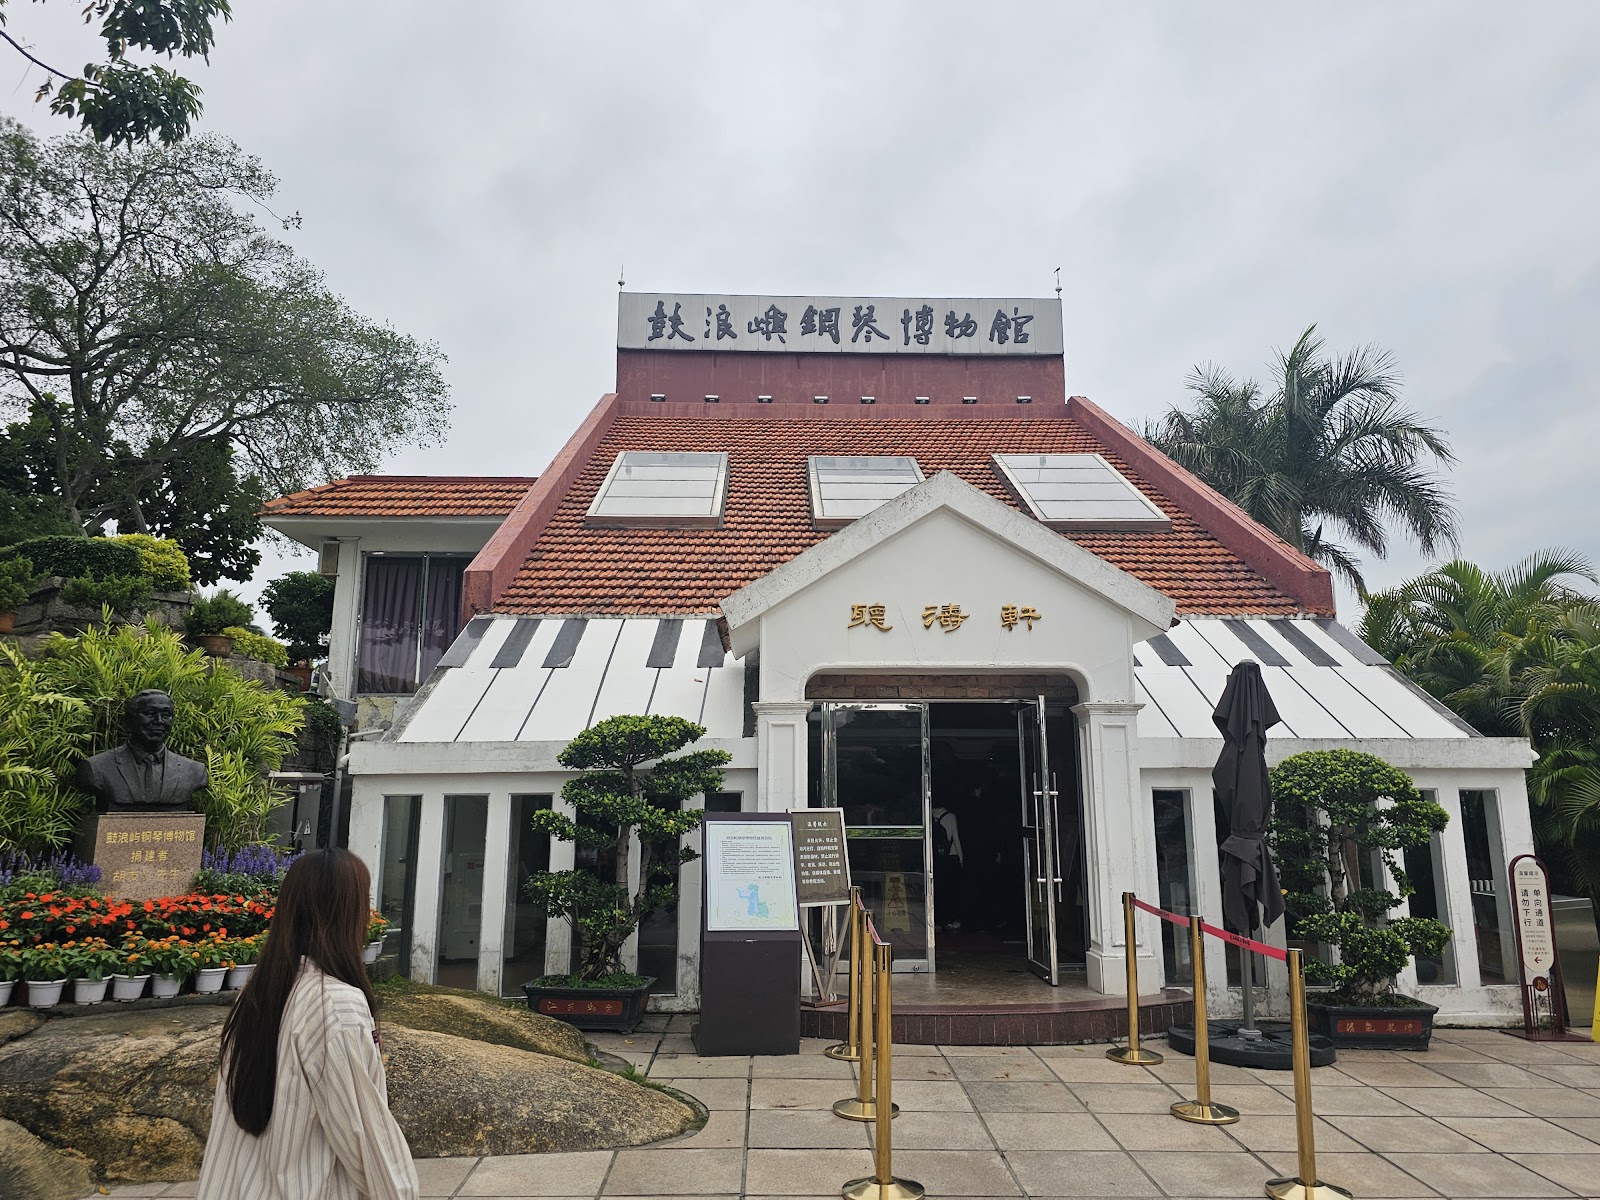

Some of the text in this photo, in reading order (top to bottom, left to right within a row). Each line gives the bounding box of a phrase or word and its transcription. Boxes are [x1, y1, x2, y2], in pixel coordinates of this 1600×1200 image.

[105, 829, 196, 844] 鼓浪屿钢琴博物馆
[130, 849, 168, 862] 捐建者
[1521, 889, 1531, 927] 请勿下行
[1533, 889, 1544, 927] 单向通道
